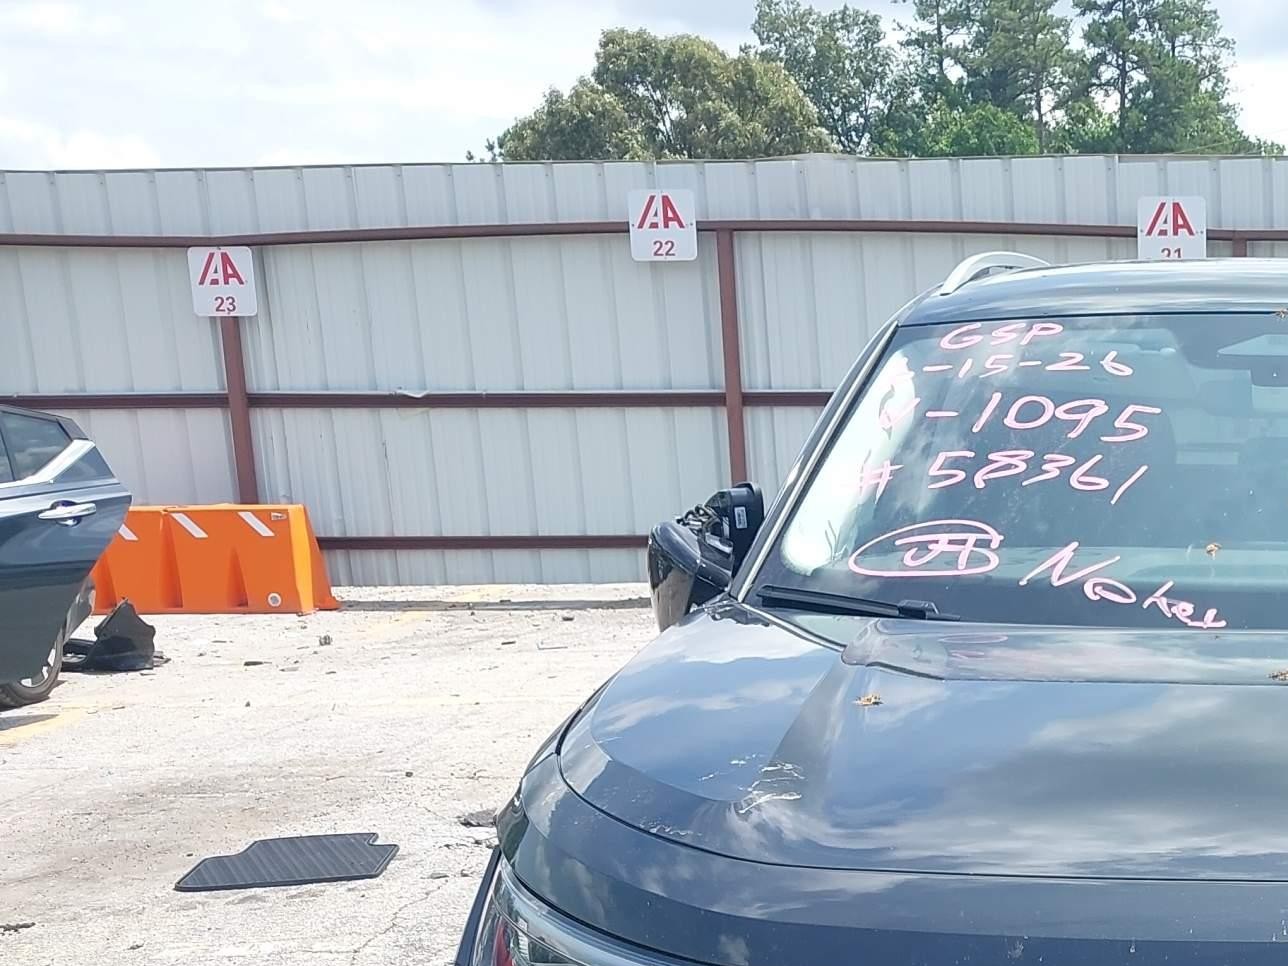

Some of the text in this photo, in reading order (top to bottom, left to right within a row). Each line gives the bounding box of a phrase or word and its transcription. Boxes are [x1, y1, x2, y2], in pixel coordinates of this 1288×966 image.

[653, 240, 676, 256] 22
[214, 296, 236, 312] 23
[940, 322, 1064, 350] GSP
[905, 350, 1134, 379] -15-26
[927, 449, 1148, 505] 58361
